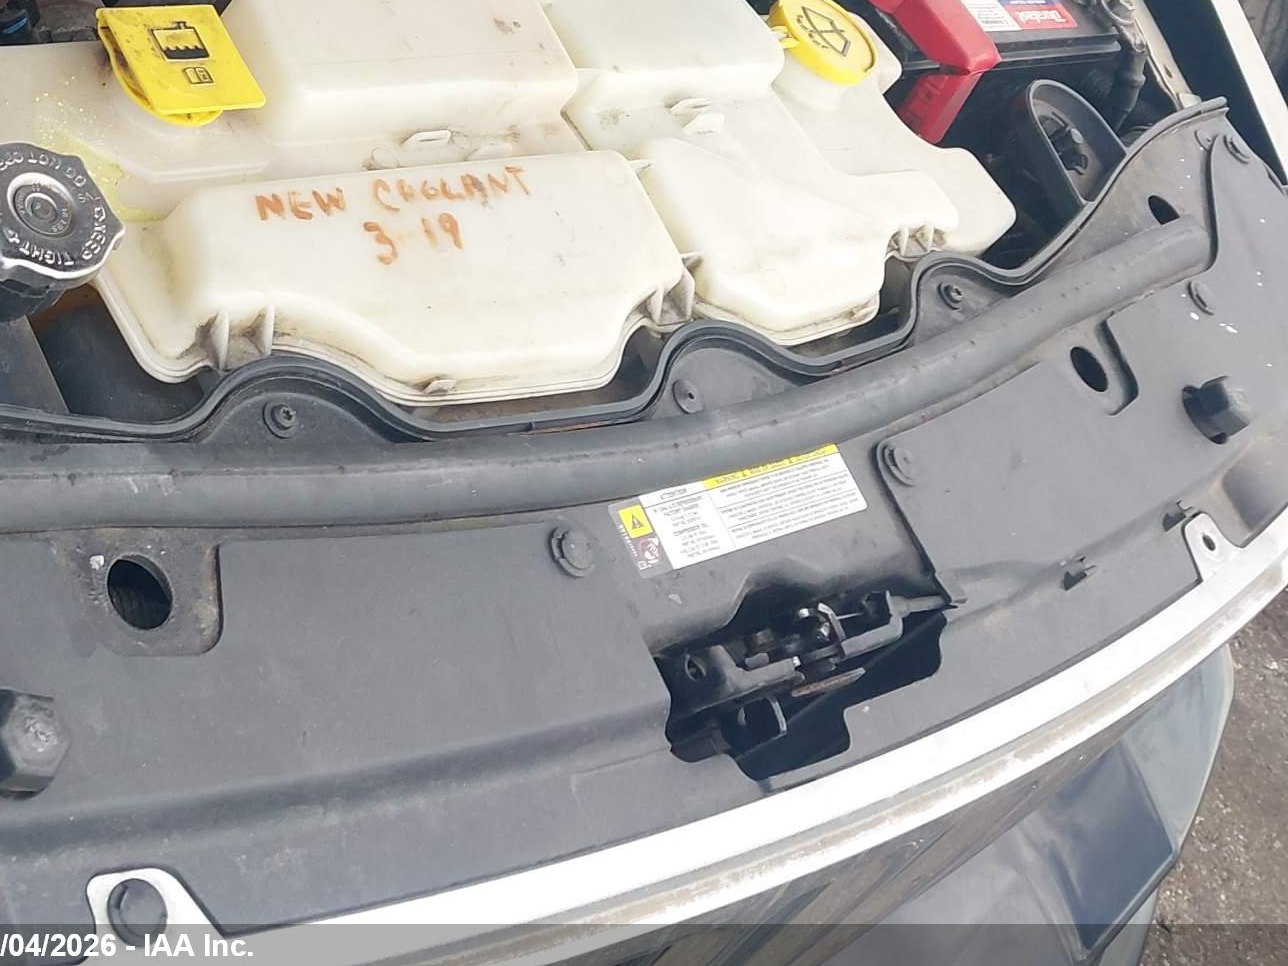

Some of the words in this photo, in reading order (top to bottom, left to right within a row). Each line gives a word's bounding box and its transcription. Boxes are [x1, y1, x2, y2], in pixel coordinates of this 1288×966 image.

[255, 187, 347, 220] NEW
[372, 166, 531, 212] COOLANT
[19, 242, 74, 266] TIGHT
